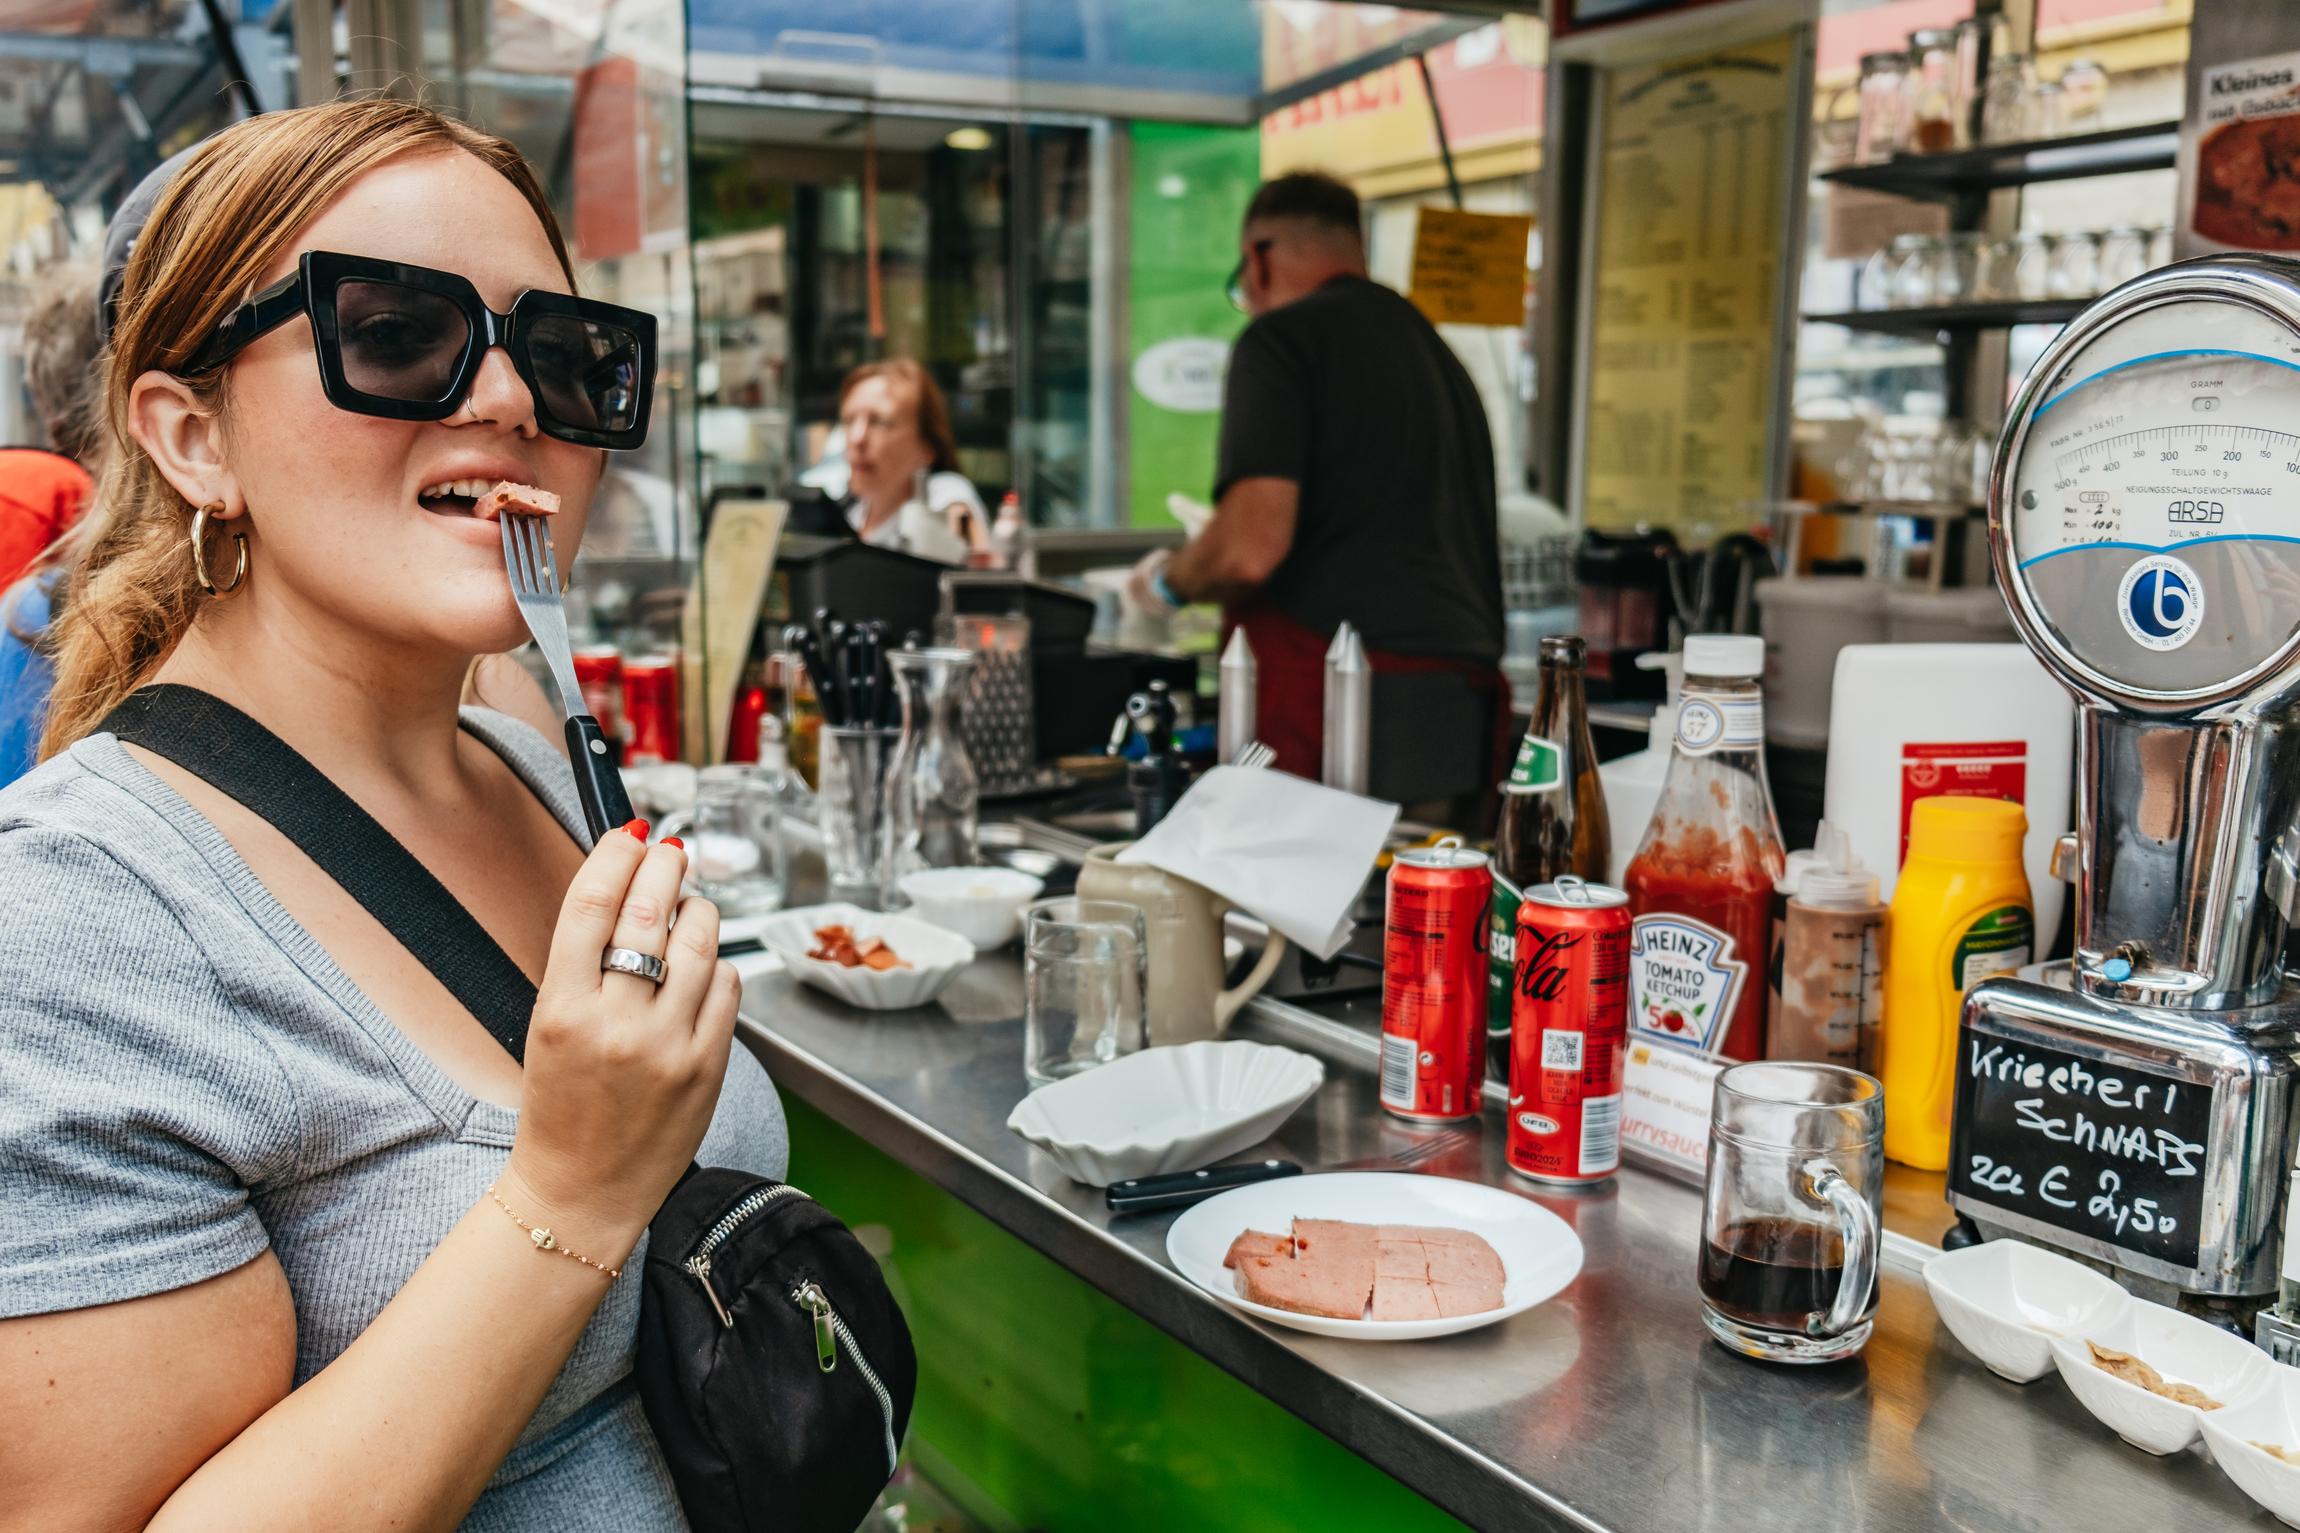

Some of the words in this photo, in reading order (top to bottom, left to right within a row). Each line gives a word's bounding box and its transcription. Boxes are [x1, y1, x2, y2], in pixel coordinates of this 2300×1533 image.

[2210, 68, 2293, 96] Kleines
[2190, 380, 2223, 389] GRAMM
[2102, 461, 2121, 472] 400
[2160, 451, 2179, 462] 300
[2194, 444, 2208, 452] 250
[2222, 451, 2242, 462] 200
[2259, 450, 2272, 459] 150
[2171, 468, 2207, 477] TEILUNG
[2212, 468, 2221, 477] 10
[2125, 485, 2273, 496] NEIGUNGSSCHALTGEWICHTSWAAGE
[2168, 500, 2225, 524] ARSA
[1645, 930, 1708, 962] HEINZ
[1644, 960, 1705, 987] TOMATO
[1646, 979, 1701, 1000] KETCHUP
[1620, 1115, 1708, 1160] urrysauc
[2038, 1164, 2078, 1209] €
[2087, 1169, 2178, 1237] 2,50
